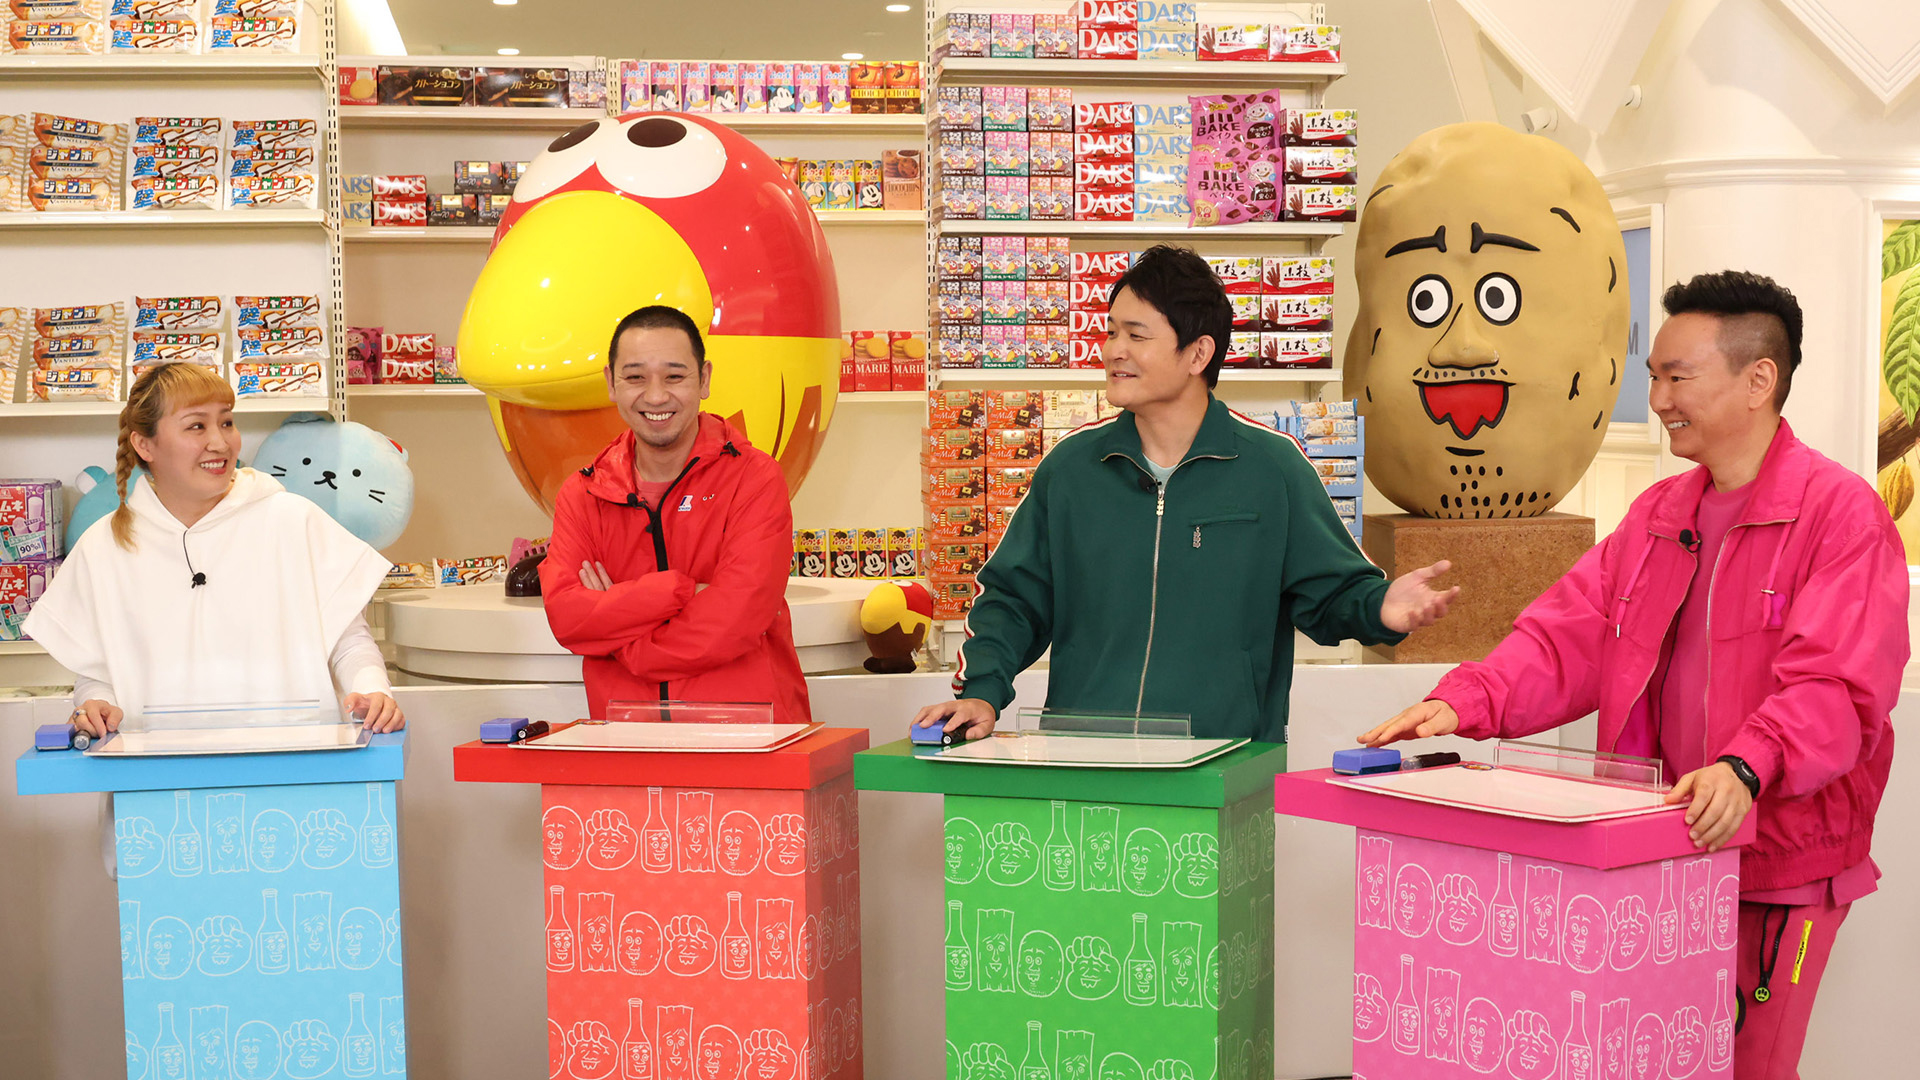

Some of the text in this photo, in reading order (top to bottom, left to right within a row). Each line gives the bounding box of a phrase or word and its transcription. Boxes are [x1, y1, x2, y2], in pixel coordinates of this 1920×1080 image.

[1079, 1, 1137, 21] DARS
[1138, 1, 1196, 22] DARS
[27, 25, 73, 36] ジャンボ
[132, 22, 178, 34] ジャンボ
[231, 20, 277, 32] ジャンボ
[1079, 30, 1137, 51] DARS
[1138, 30, 1196, 52] DARS
[1290, 31, 1317, 45] 小枝
[415, 79, 461, 89] ガトーショコラ
[510, 80, 557, 91] ガトーショコラ
[1075, 104, 1134, 125] DARS
[1135, 104, 1191, 125] DARS
[52, 119, 99, 135] ジャンボ
[157, 117, 203, 127] ジャンボ
[254, 121, 299, 131] ジャンボ
[1307, 115, 1333, 129] 小枝
[1197, 122, 1241, 137] BAKE
[1207, 132, 1231, 141] ベイク
[1075, 133, 1134, 155] DARS
[1135, 134, 1192, 155] DARS
[47, 149, 94, 161] ジャンボ
[153, 147, 201, 159] ジャンボ
[252, 150, 297, 160] ジャンボ
[1075, 163, 1134, 184] DARS
[44, 181, 92, 194] ジャンボ
[153, 180, 200, 190] ジャンボ
[250, 179, 296, 190] ジャンボ
[374, 176, 427, 194] DARS
[1198, 182, 1245, 191] BAKE
[1210, 191, 1235, 199] ベイク
[1307, 190, 1332, 204] 小枝
[1075, 192, 1134, 213] DARS
[1135, 193, 1191, 214] DARS
[375, 201, 427, 220] DARS
[1071, 252, 1129, 274] DARS
[1285, 263, 1310, 277] 小枝
[156, 299, 202, 310] ジャンボ
[258, 299, 304, 310] ジャンボ
[1283, 299, 1308, 314] 小枝
[51, 308, 96, 321] ジャンボ
[155, 335, 201, 345] ジャンボ
[259, 330, 306, 342] ジャンボ
[49, 339, 94, 352] ジャンボ
[382, 334, 433, 353] DARS
[1282, 338, 1308, 352] 小枝
[257, 366, 304, 377] ジャンボ
[382, 359, 434, 378] DARS
[856, 363, 889, 374] MARIE
[46, 371, 92, 383] ジャンボ
[939, 411, 959, 420] Milk
[997, 411, 1016, 420] Milk
[939, 449, 958, 458] Milk
[995, 449, 1015, 458] Milk
[939, 488, 958, 497] Milk
[996, 488, 1016, 497] Milk
[941, 526, 960, 535] Milk
[939, 565, 959, 573] Milk
[941, 602, 961, 611] Milk
